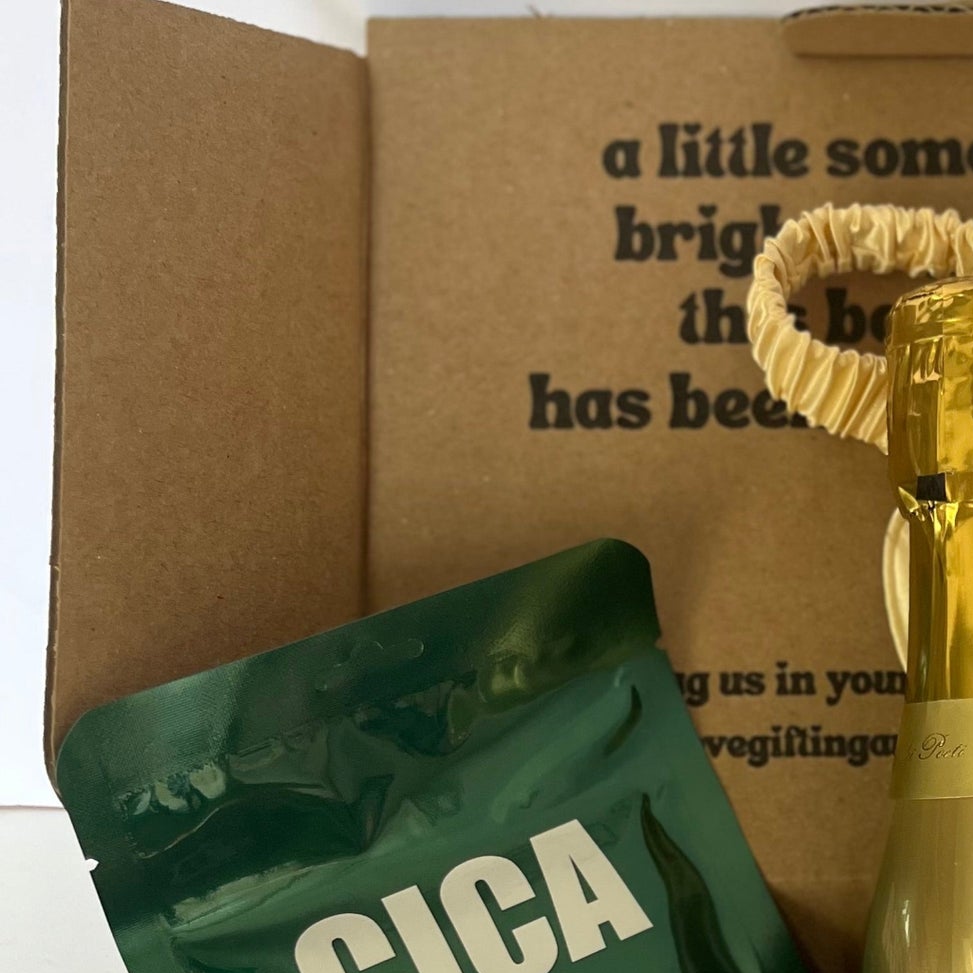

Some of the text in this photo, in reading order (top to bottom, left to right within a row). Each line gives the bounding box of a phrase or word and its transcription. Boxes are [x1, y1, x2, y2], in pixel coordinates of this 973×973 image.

[603, 137, 640, 178] a
[657, 123, 809, 178] little
[679, 287, 809, 345] ths
[528, 371, 825, 430] has bee
[719, 671, 765, 696] us
[775, 660, 816, 696] in
